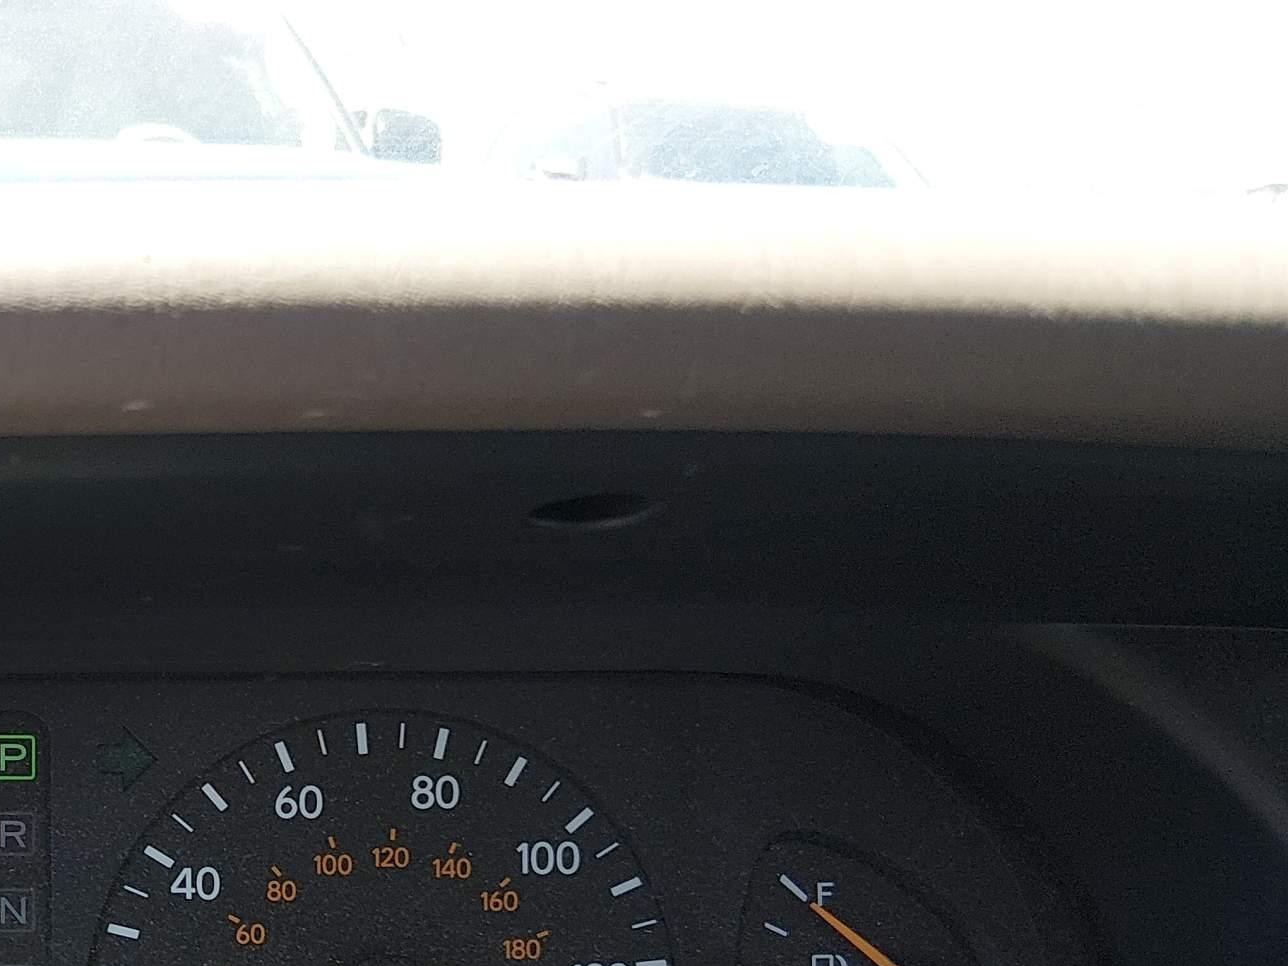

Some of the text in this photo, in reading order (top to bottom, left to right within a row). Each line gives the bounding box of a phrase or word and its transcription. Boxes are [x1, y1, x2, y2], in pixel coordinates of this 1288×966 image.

[0, 744, 26, 771] P
[275, 786, 322, 820] 60
[411, 776, 460, 809] 80
[0, 821, 26, 848] R
[314, 854, 352, 876] 100
[372, 848, 409, 868] 120
[433, 858, 471, 879] 140
[516, 842, 580, 876] 100
[170, 867, 220, 900] 40
[266, 880, 296, 902] 80
[817, 882, 834, 905] F
[0, 897, 26, 924] N
[480, 891, 518, 912] 160
[236, 924, 265, 944] 60
[504, 939, 540, 960] 180
